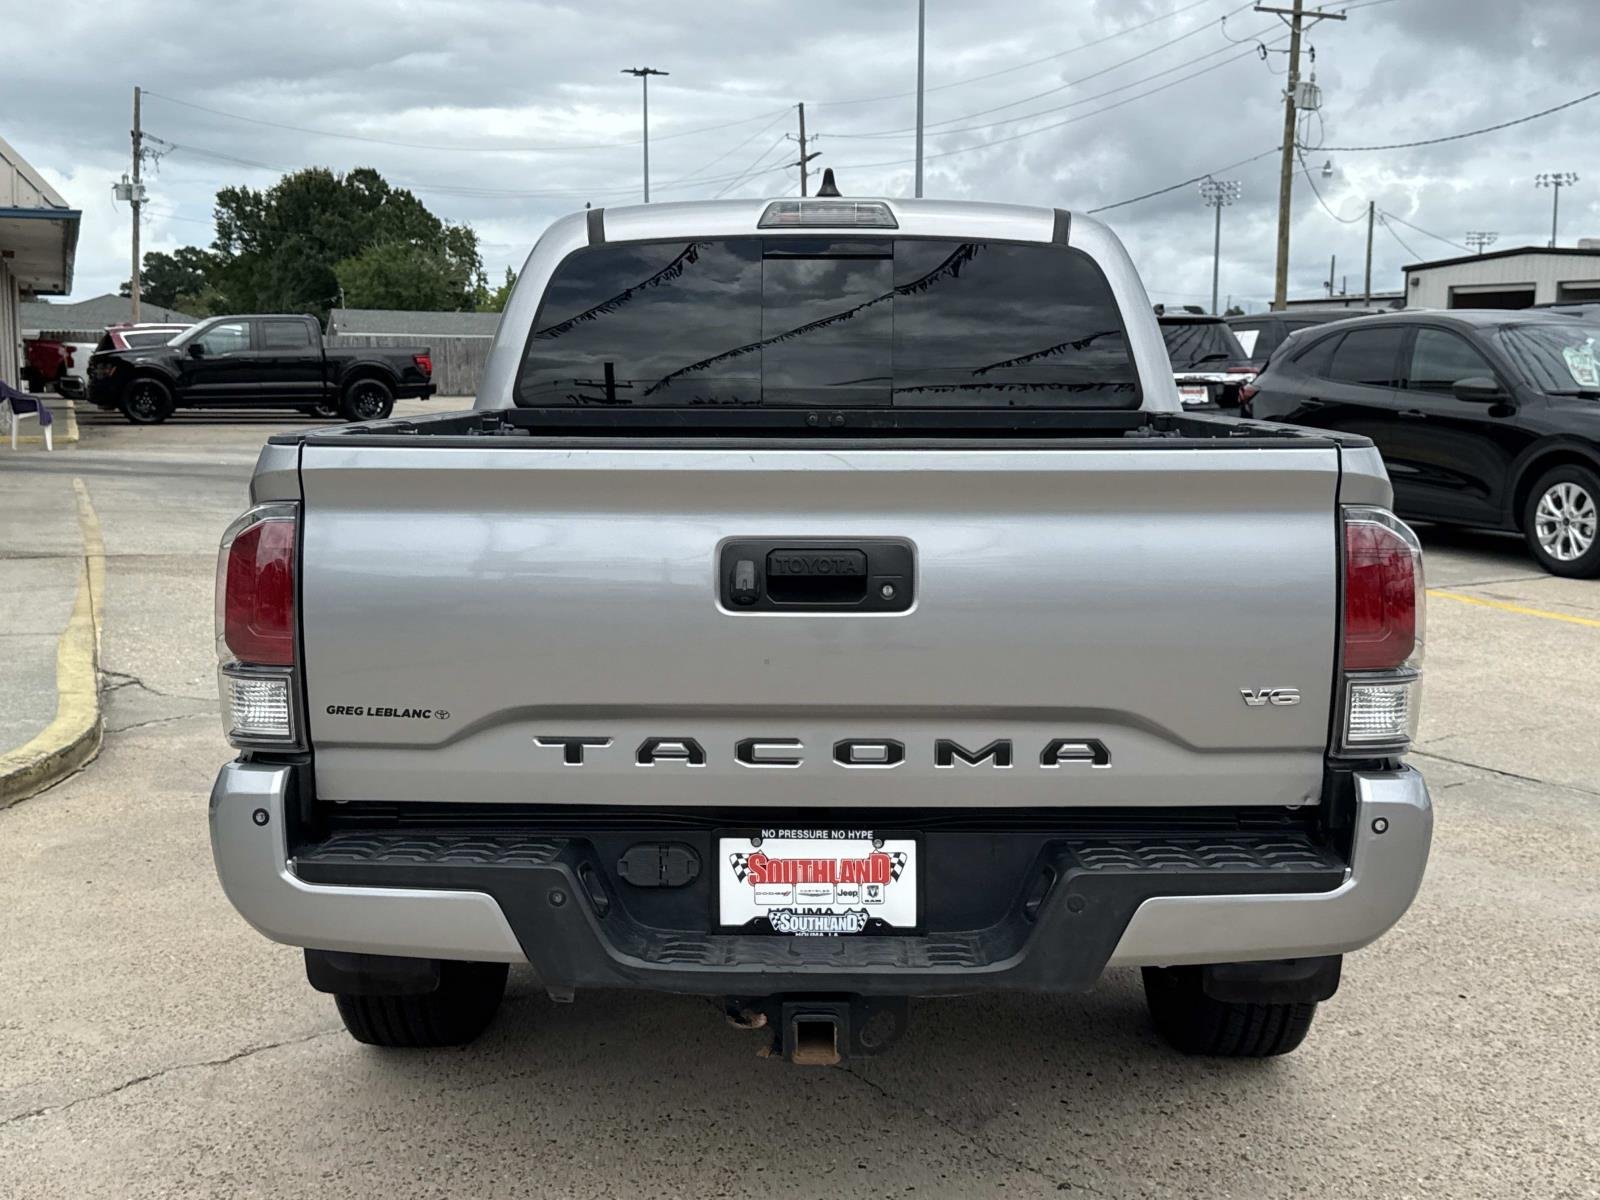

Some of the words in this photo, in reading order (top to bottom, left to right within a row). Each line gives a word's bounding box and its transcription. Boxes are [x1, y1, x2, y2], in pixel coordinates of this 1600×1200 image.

[775, 556, 857, 574] TOYOTA
[1240, 688, 1300, 706] V6
[326, 705, 364, 716] GREG
[367, 707, 432, 719] LEBLANC
[533, 736, 1113, 769] TACOMA
[761, 829, 776, 838] NO
[778, 829, 829, 839] PRESSURE
[831, 830, 846, 839] NO
[848, 830, 874, 839] HYPE
[837, 889, 858, 898] Jeep
